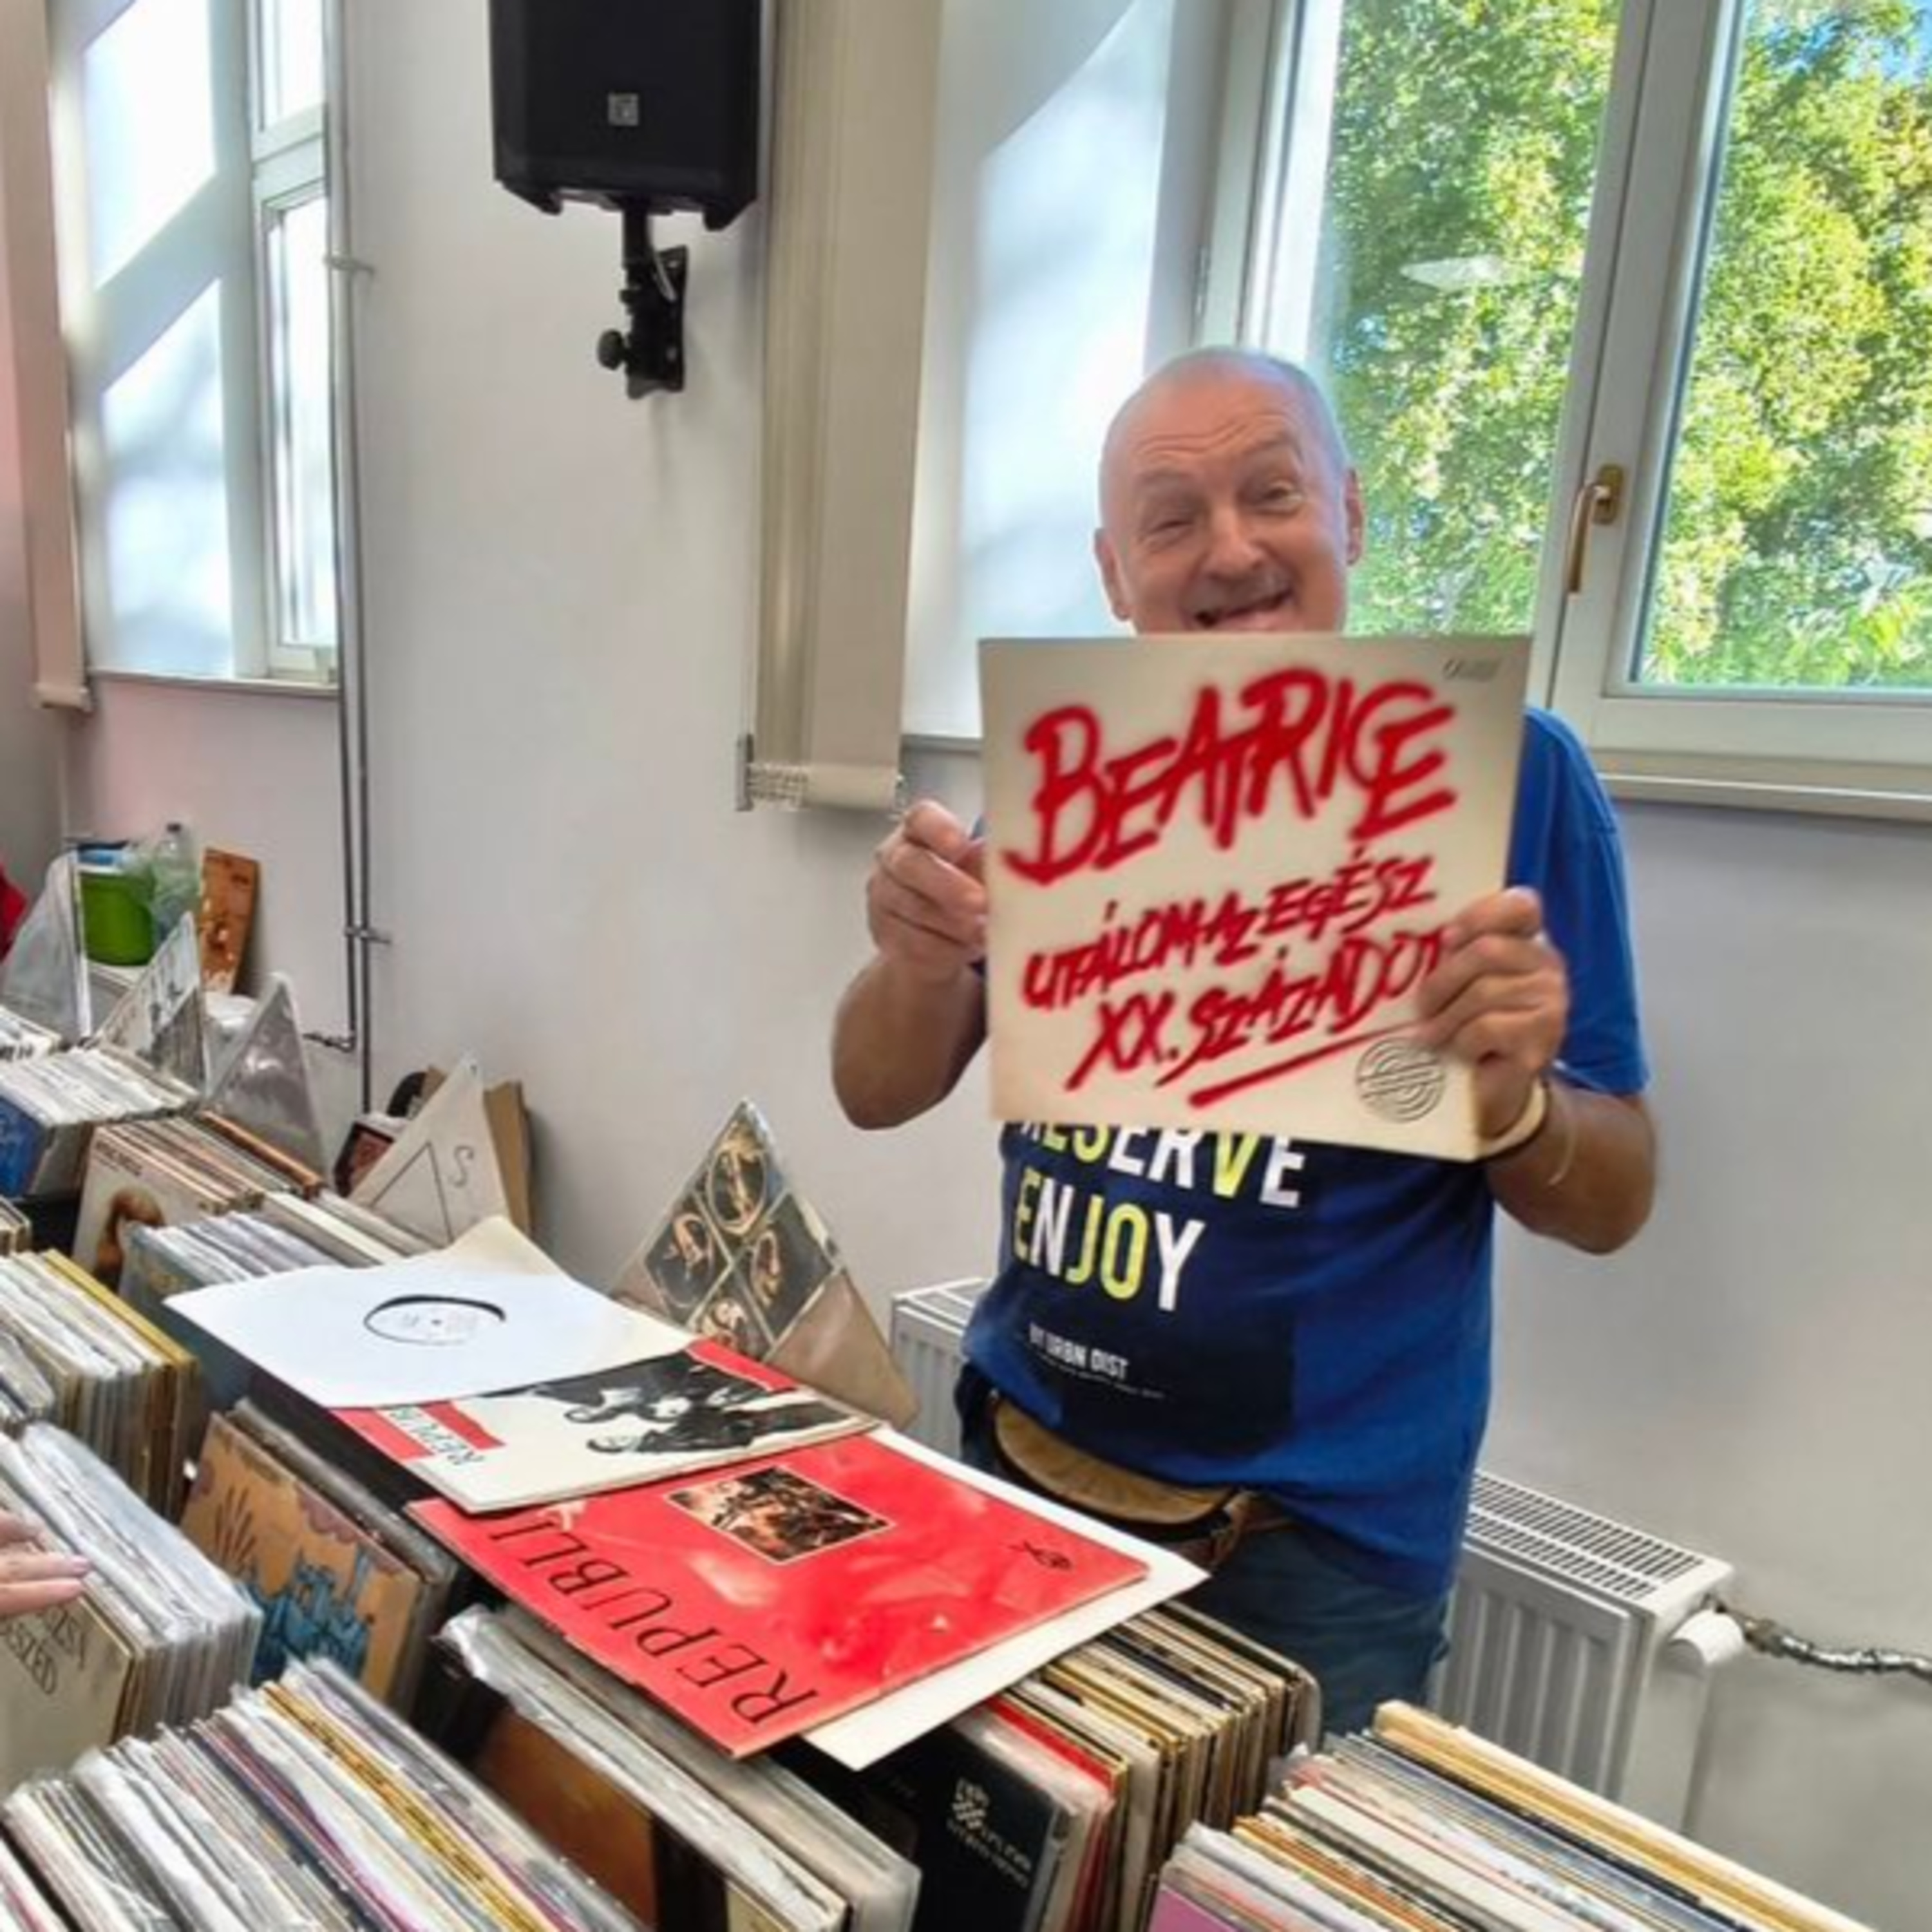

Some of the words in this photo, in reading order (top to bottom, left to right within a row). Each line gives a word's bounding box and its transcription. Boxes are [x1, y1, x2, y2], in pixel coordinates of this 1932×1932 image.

[1001, 668, 1458, 887] BEATRICE
[1023, 899, 1203, 1011] UTÁLOM
[1203, 891, 1260, 967] AZ
[1259, 848, 1437, 942] EGÉSZ
[1014, 1166, 1207, 1312] ENJOY
